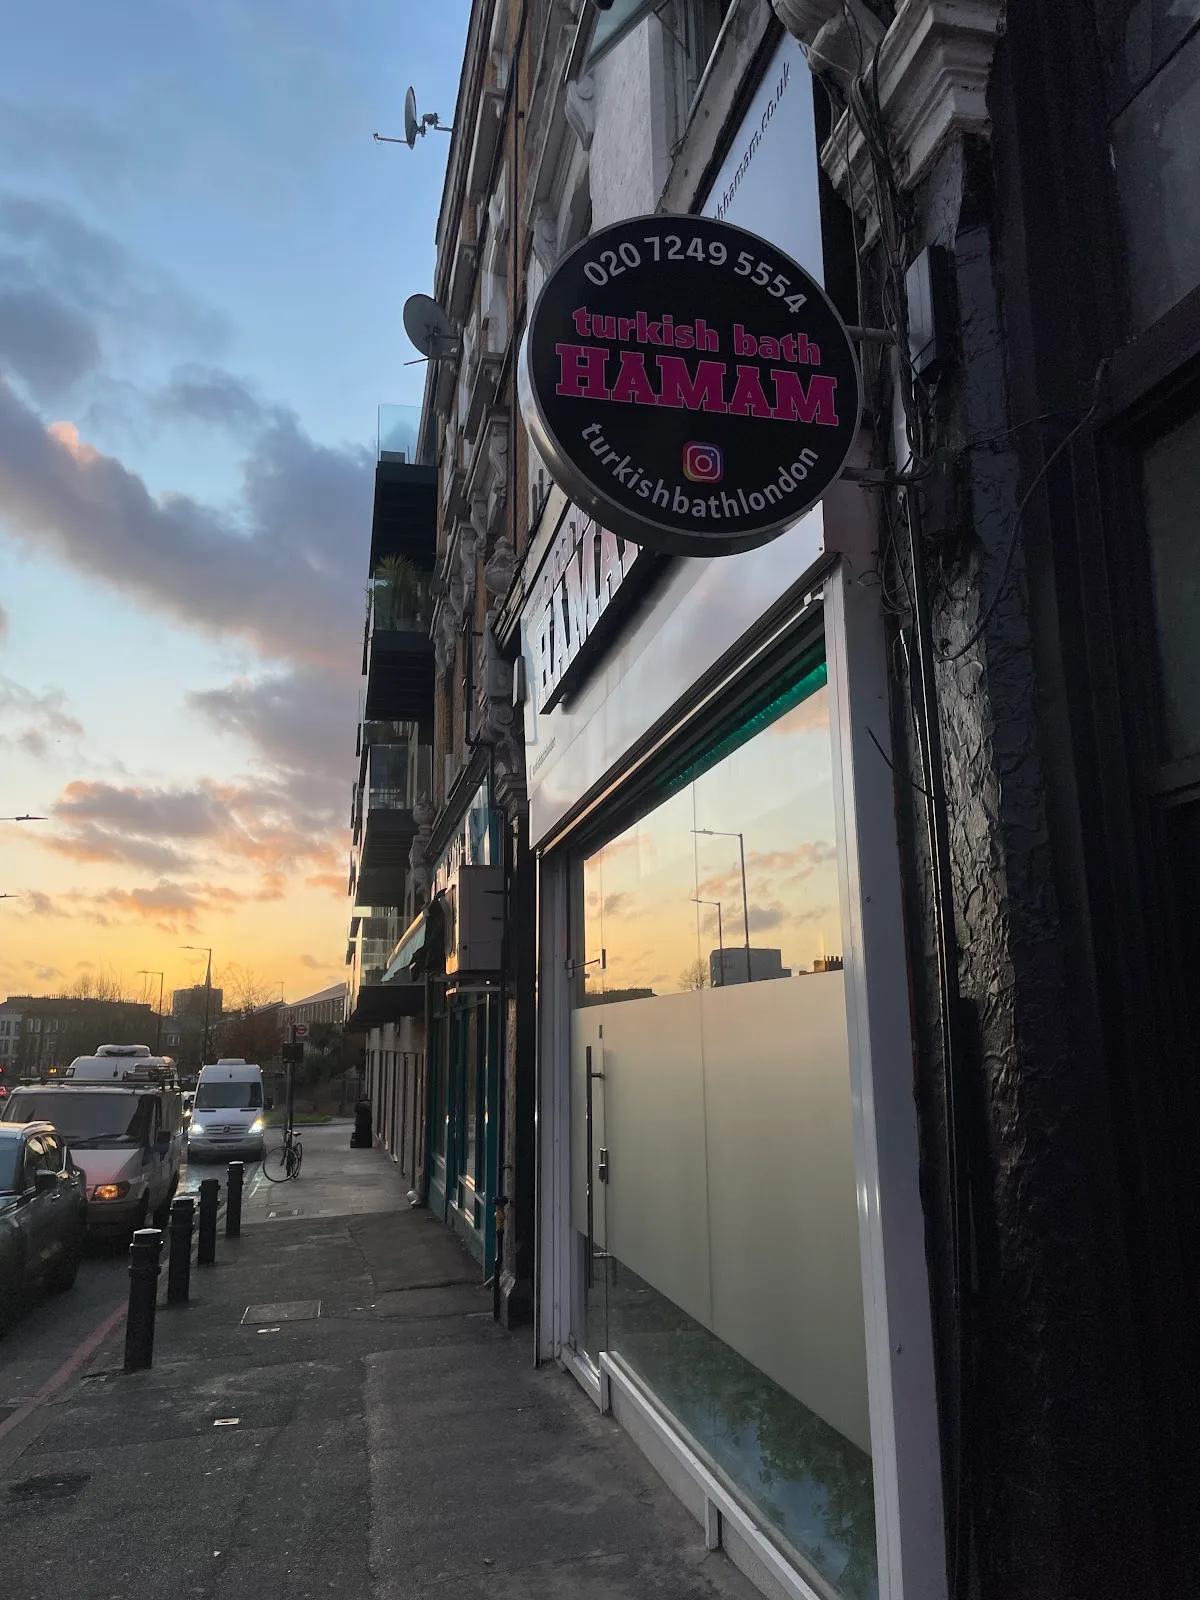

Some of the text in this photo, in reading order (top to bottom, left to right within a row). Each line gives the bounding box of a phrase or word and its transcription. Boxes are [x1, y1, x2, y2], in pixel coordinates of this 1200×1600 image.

[583, 235, 808, 314] 020 7249 5554
[572, 305, 821, 366] turkish bath
[555, 342, 840, 427] HAMAM
[581, 421, 820, 519] turkishbathlondon
